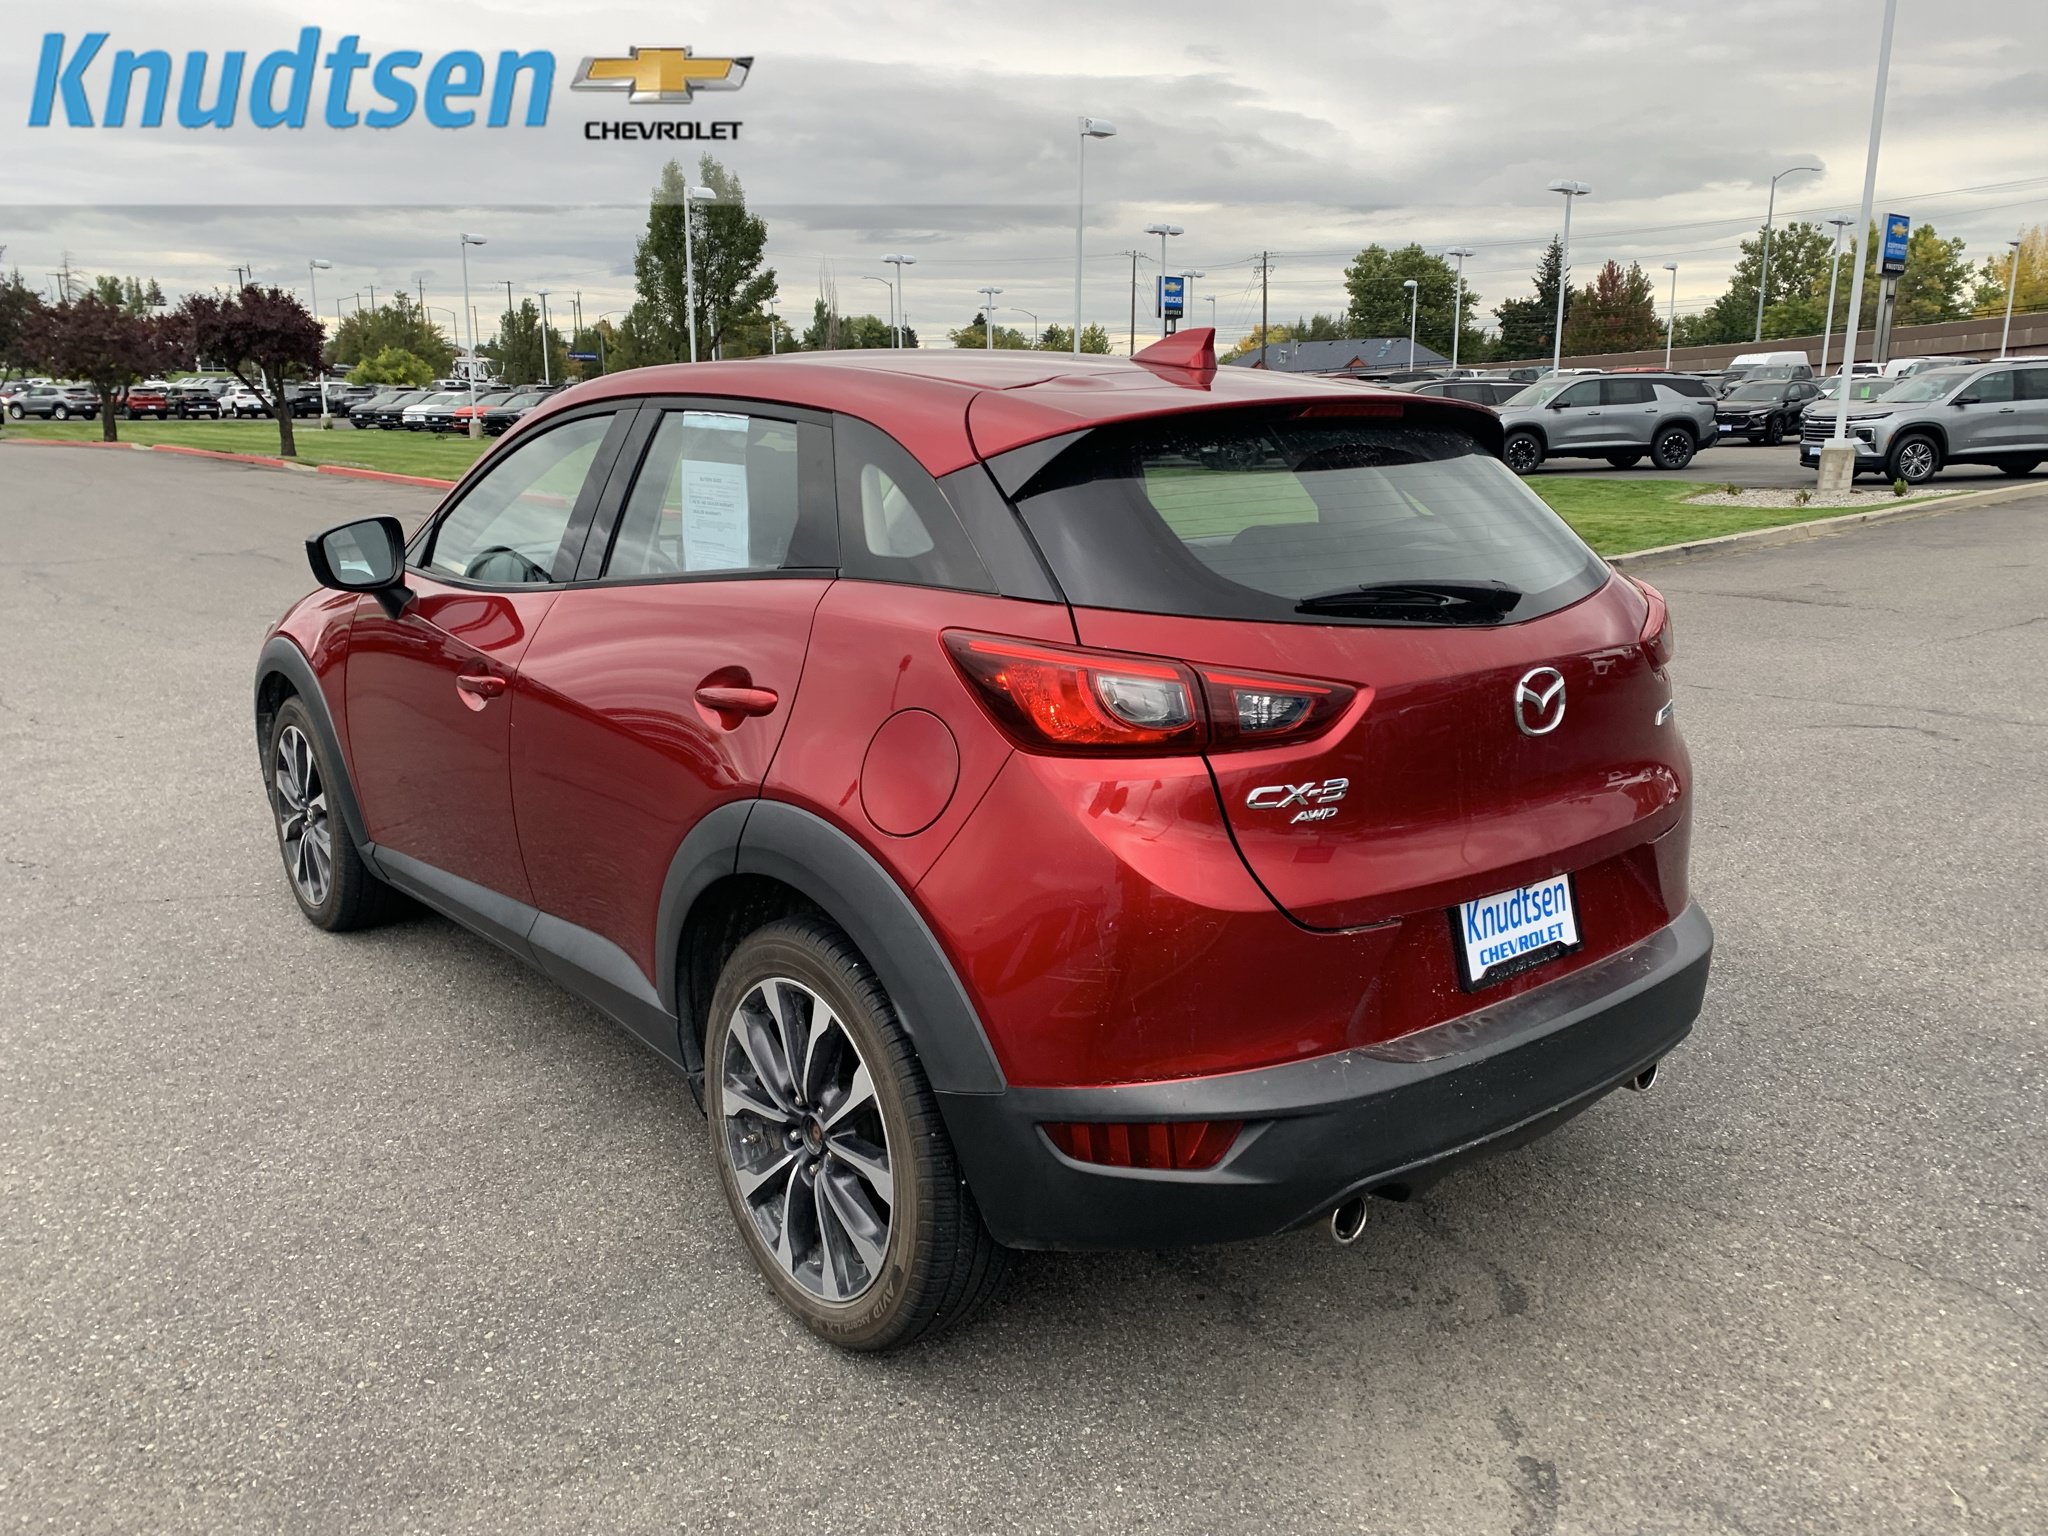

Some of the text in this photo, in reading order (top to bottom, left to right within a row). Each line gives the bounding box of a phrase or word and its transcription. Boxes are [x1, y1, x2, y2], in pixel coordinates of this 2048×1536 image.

[1246, 778, 1350, 809] CX-3
[1290, 807, 1338, 824] AWD
[1466, 882, 1566, 944] Knudtsen
[1480, 922, 1564, 966] CHEVROLET
[873, 1280, 895, 1319] AVID
